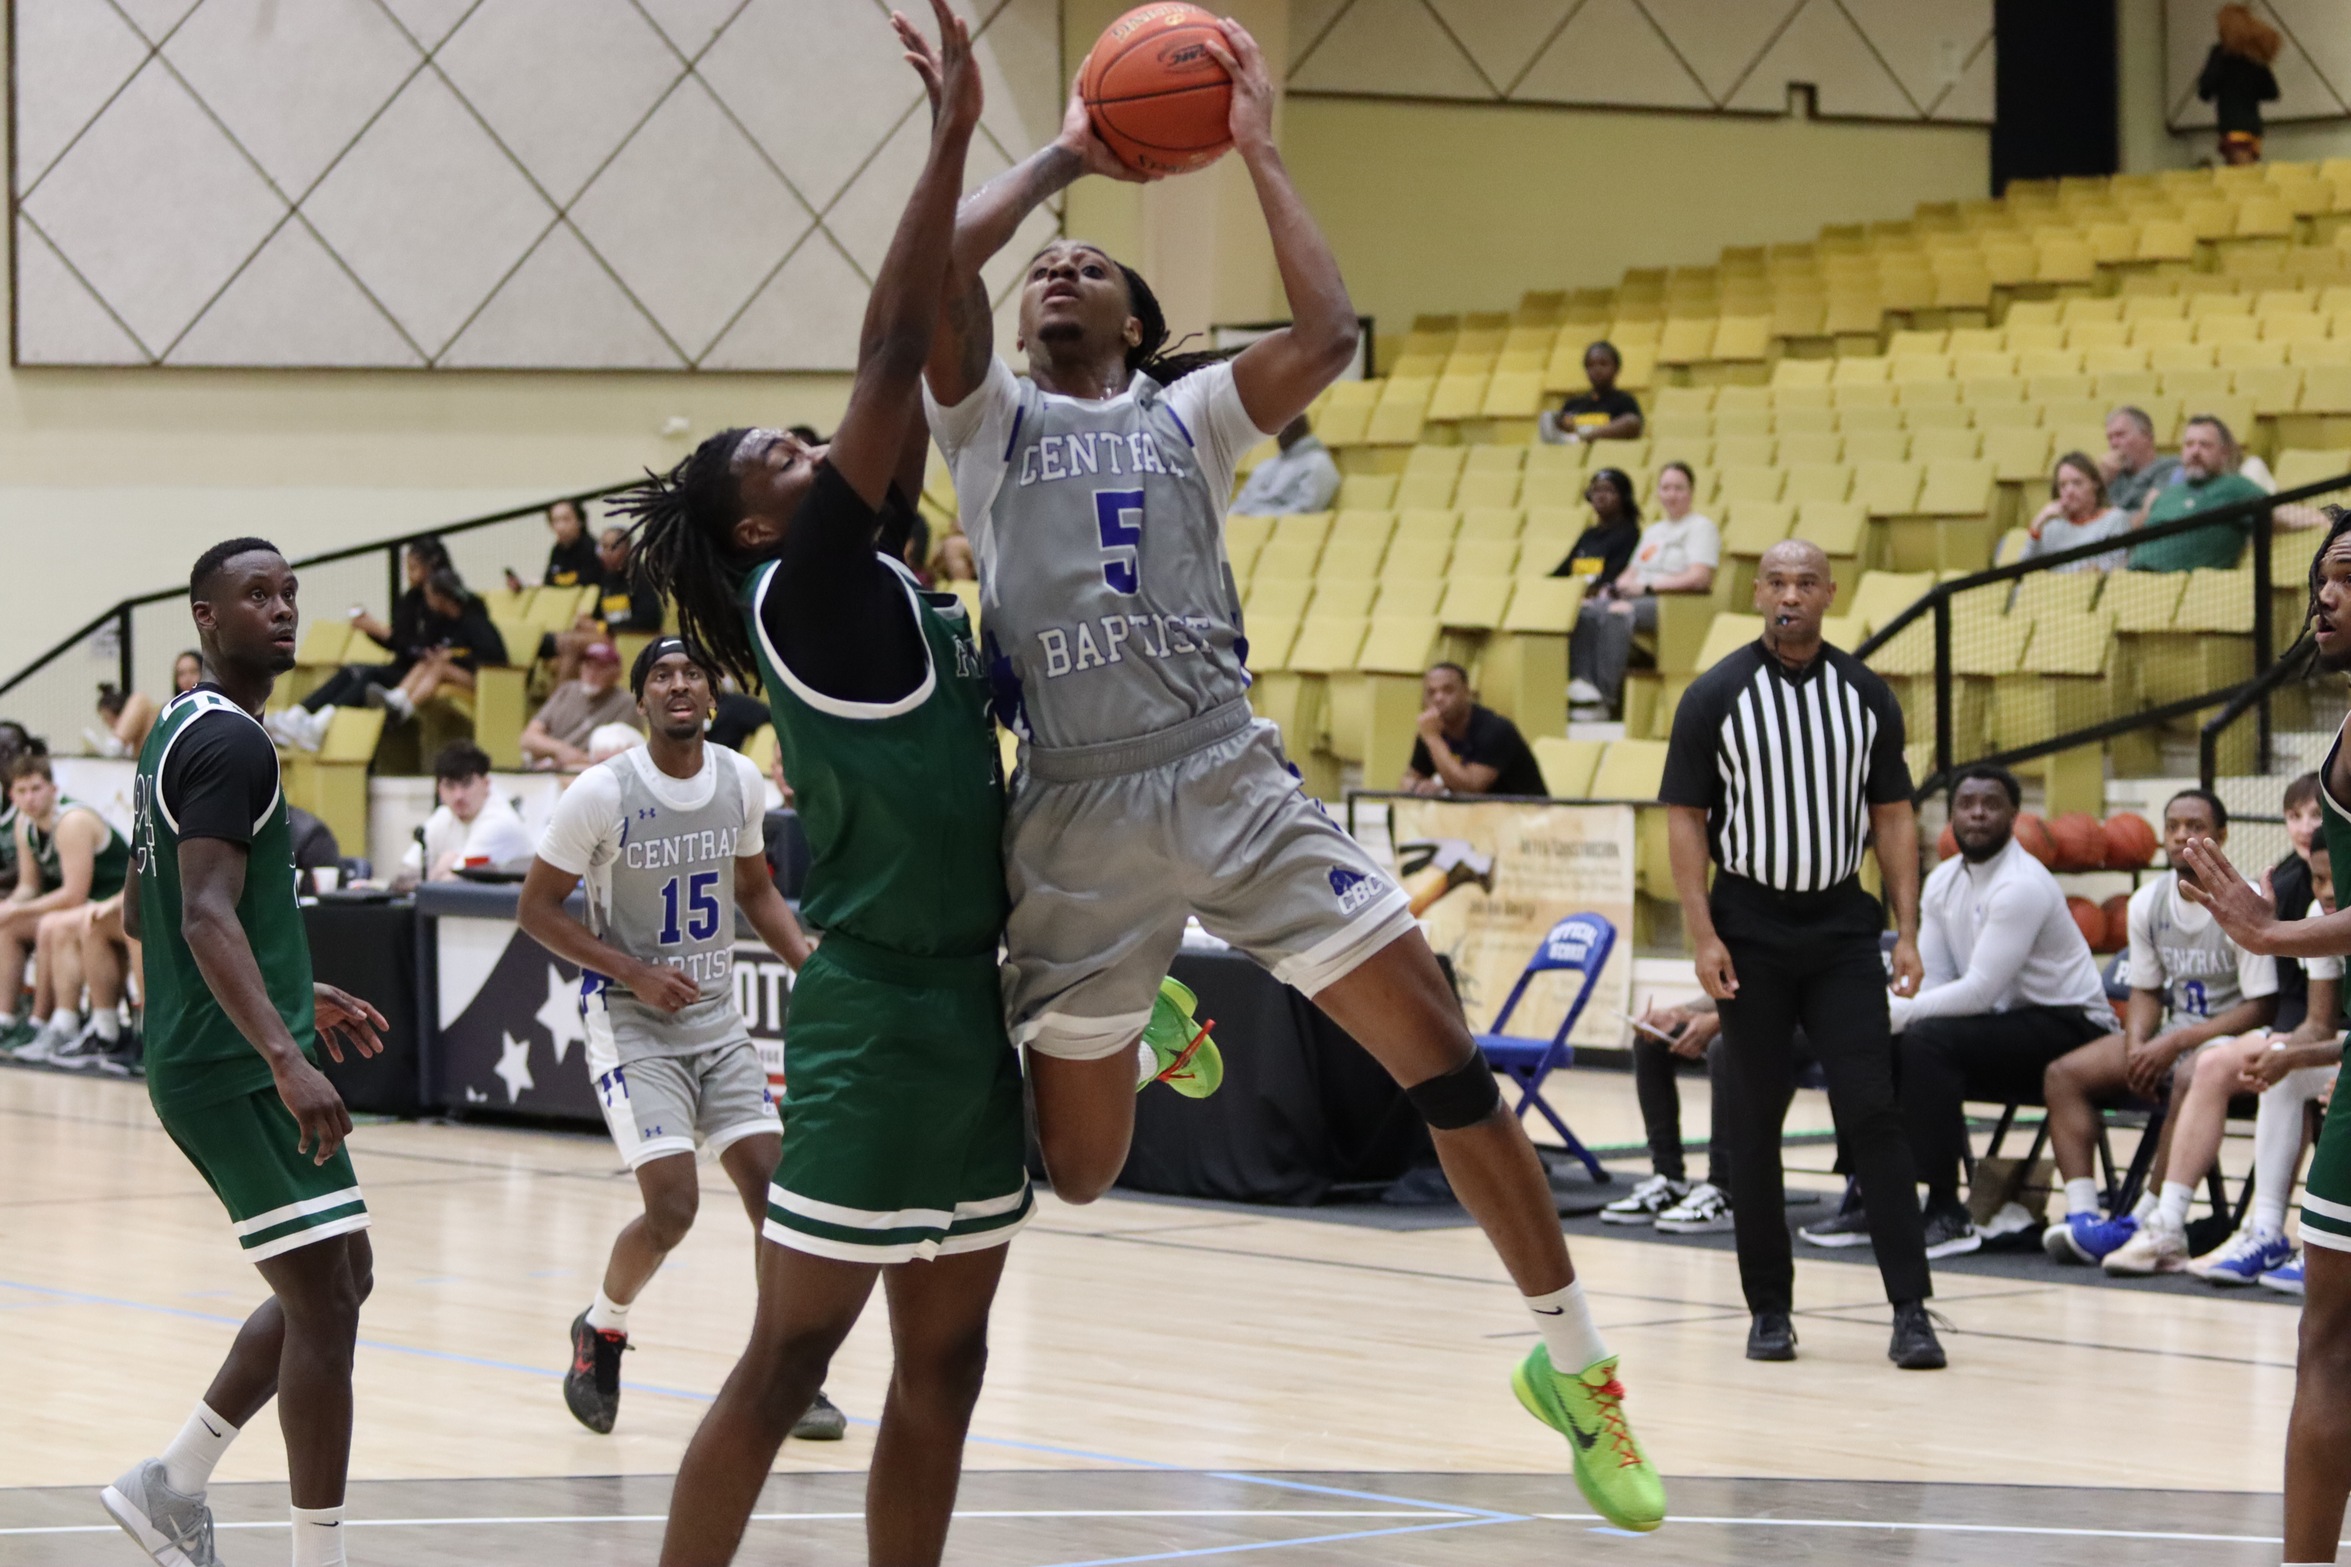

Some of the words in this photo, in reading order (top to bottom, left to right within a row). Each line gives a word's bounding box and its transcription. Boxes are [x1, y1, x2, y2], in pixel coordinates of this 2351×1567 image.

[1092, 486, 1145, 596] 5
[659, 869, 719, 946] 15
[1337, 872, 1384, 915] CBC
[635, 945, 736, 983] PTIST
[2161, 946, 2235, 974] ENTRAL
